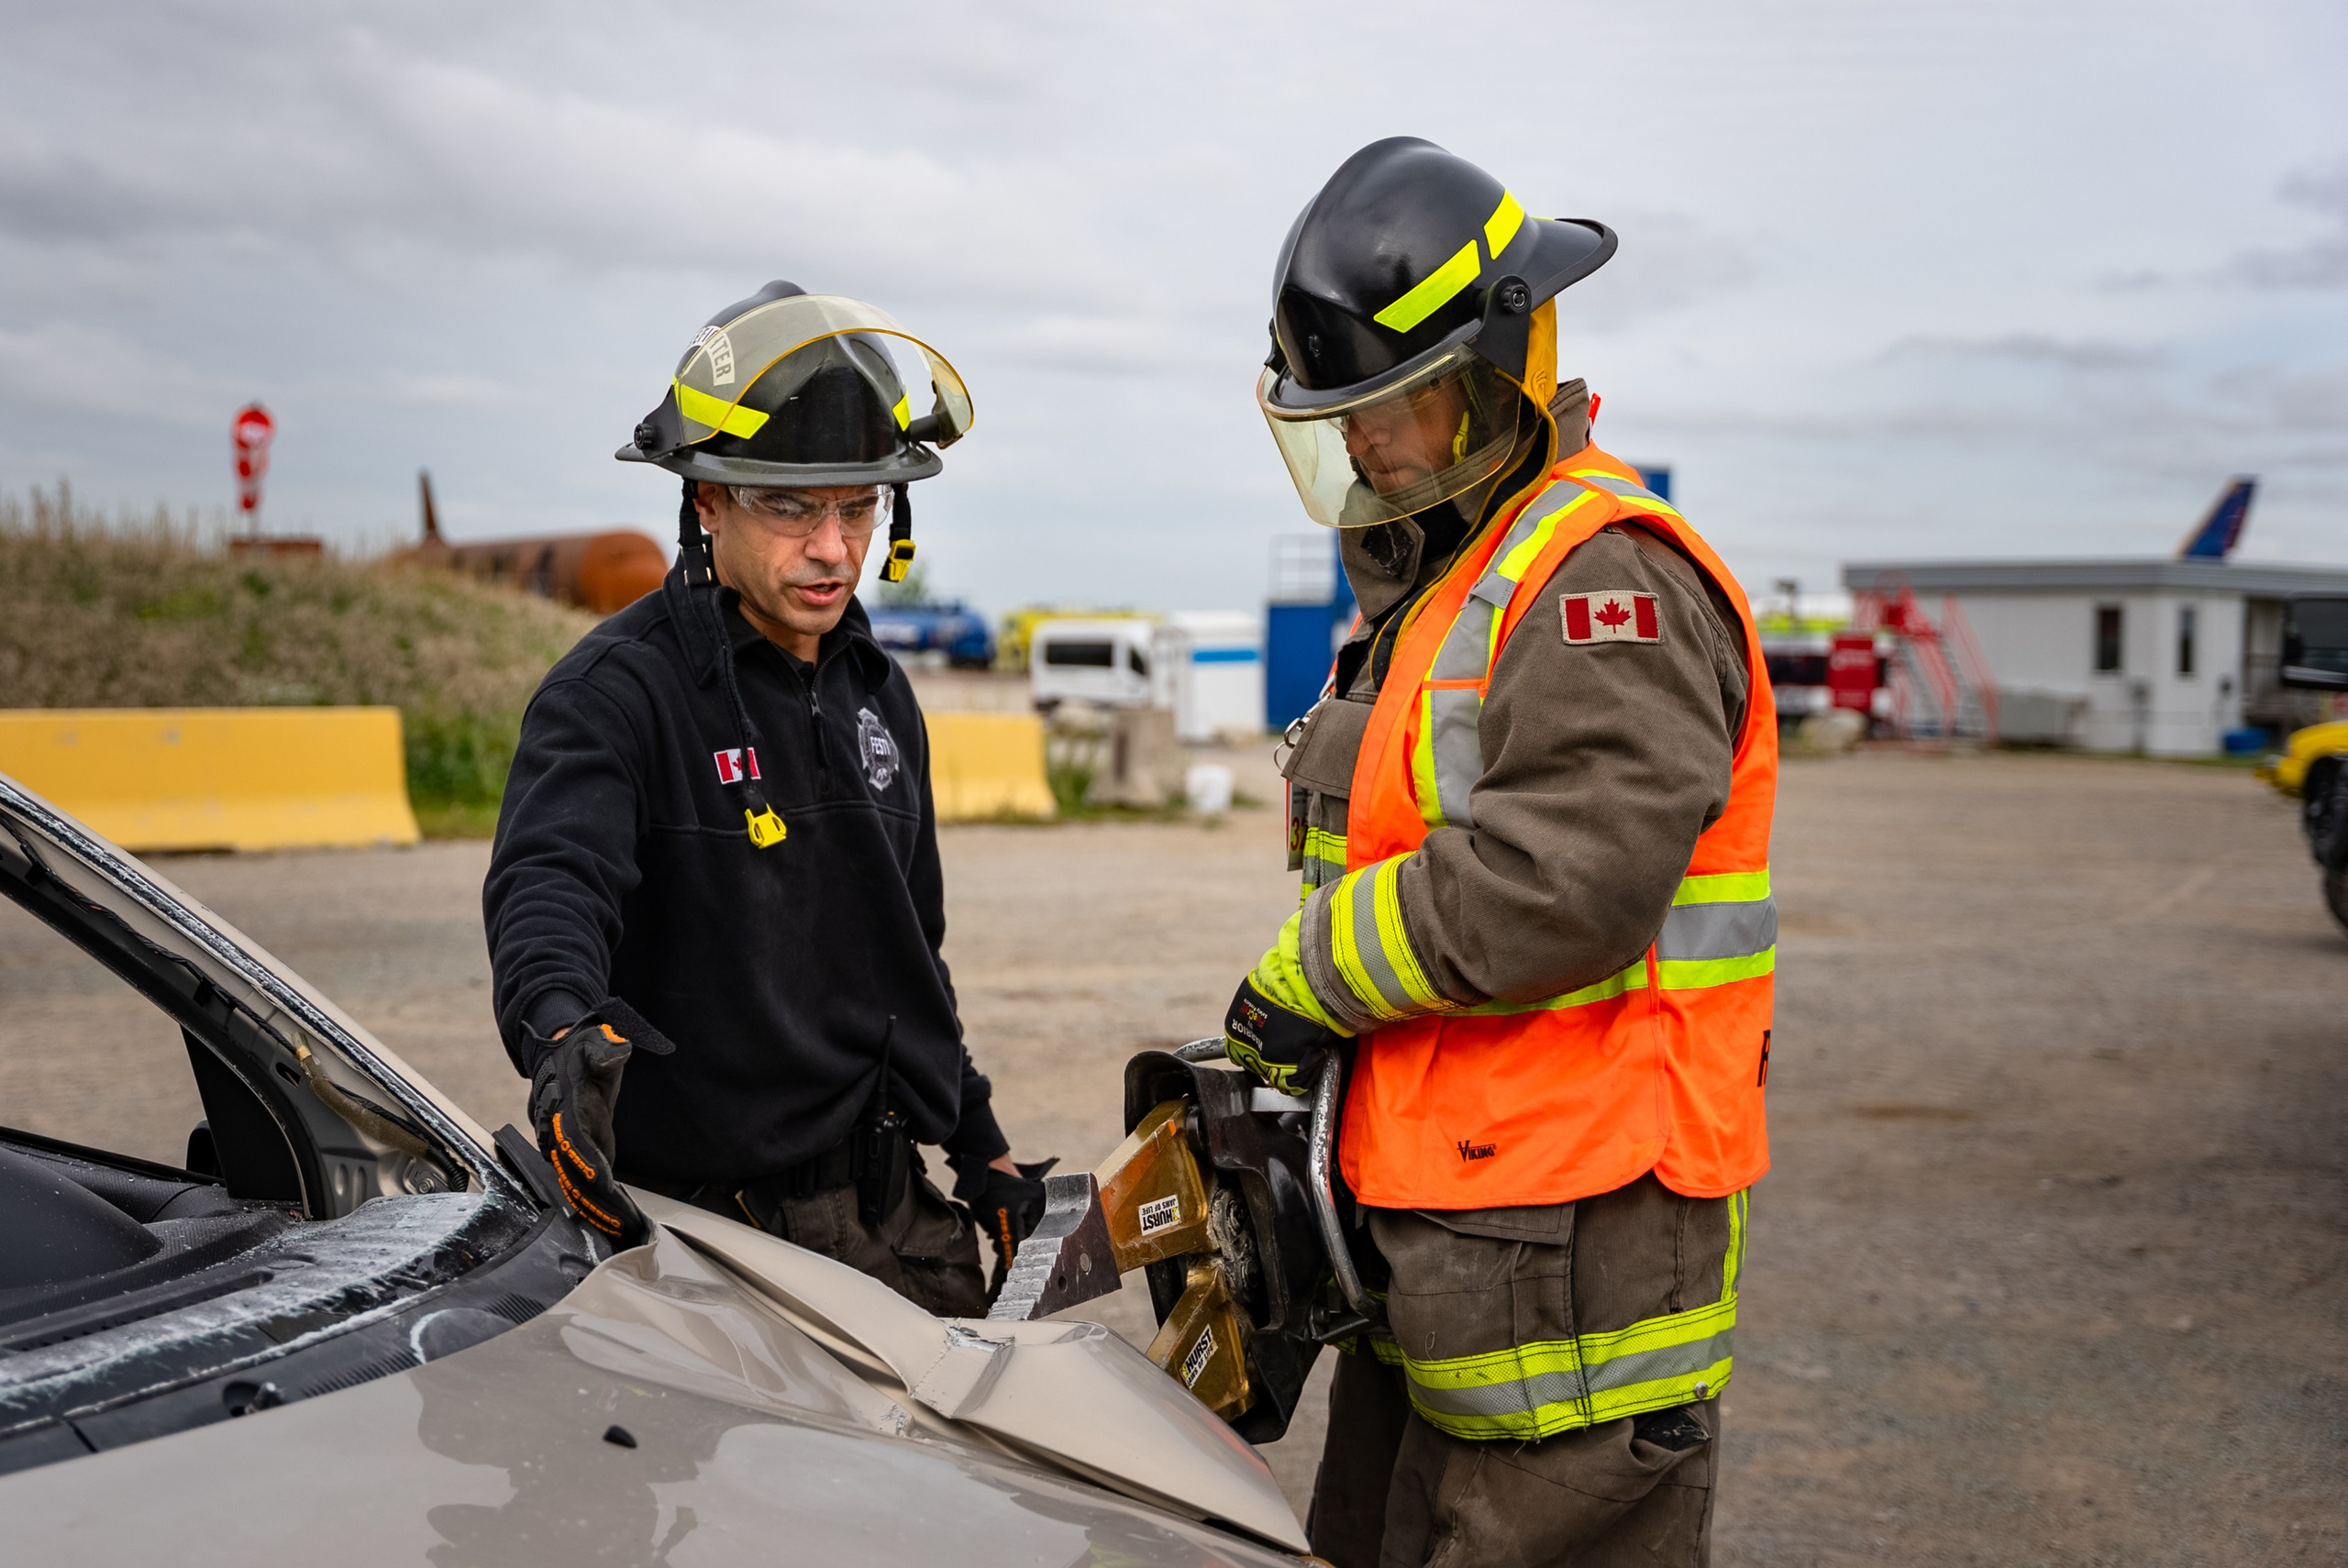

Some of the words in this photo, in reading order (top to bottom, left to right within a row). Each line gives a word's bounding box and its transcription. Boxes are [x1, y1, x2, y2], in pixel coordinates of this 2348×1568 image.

[869, 736, 891, 755] FESTI
[1232, 1019, 1263, 1051] WARRIOR
[1142, 1206, 1153, 1215] LIFE
[1155, 1203, 1161, 1211] OF
[1162, 1198, 1176, 1209] JAWS
[1143, 1209, 1173, 1231] HURST
[1186, 1328, 1212, 1374] HURST
[1198, 1357, 1204, 1369] OF
